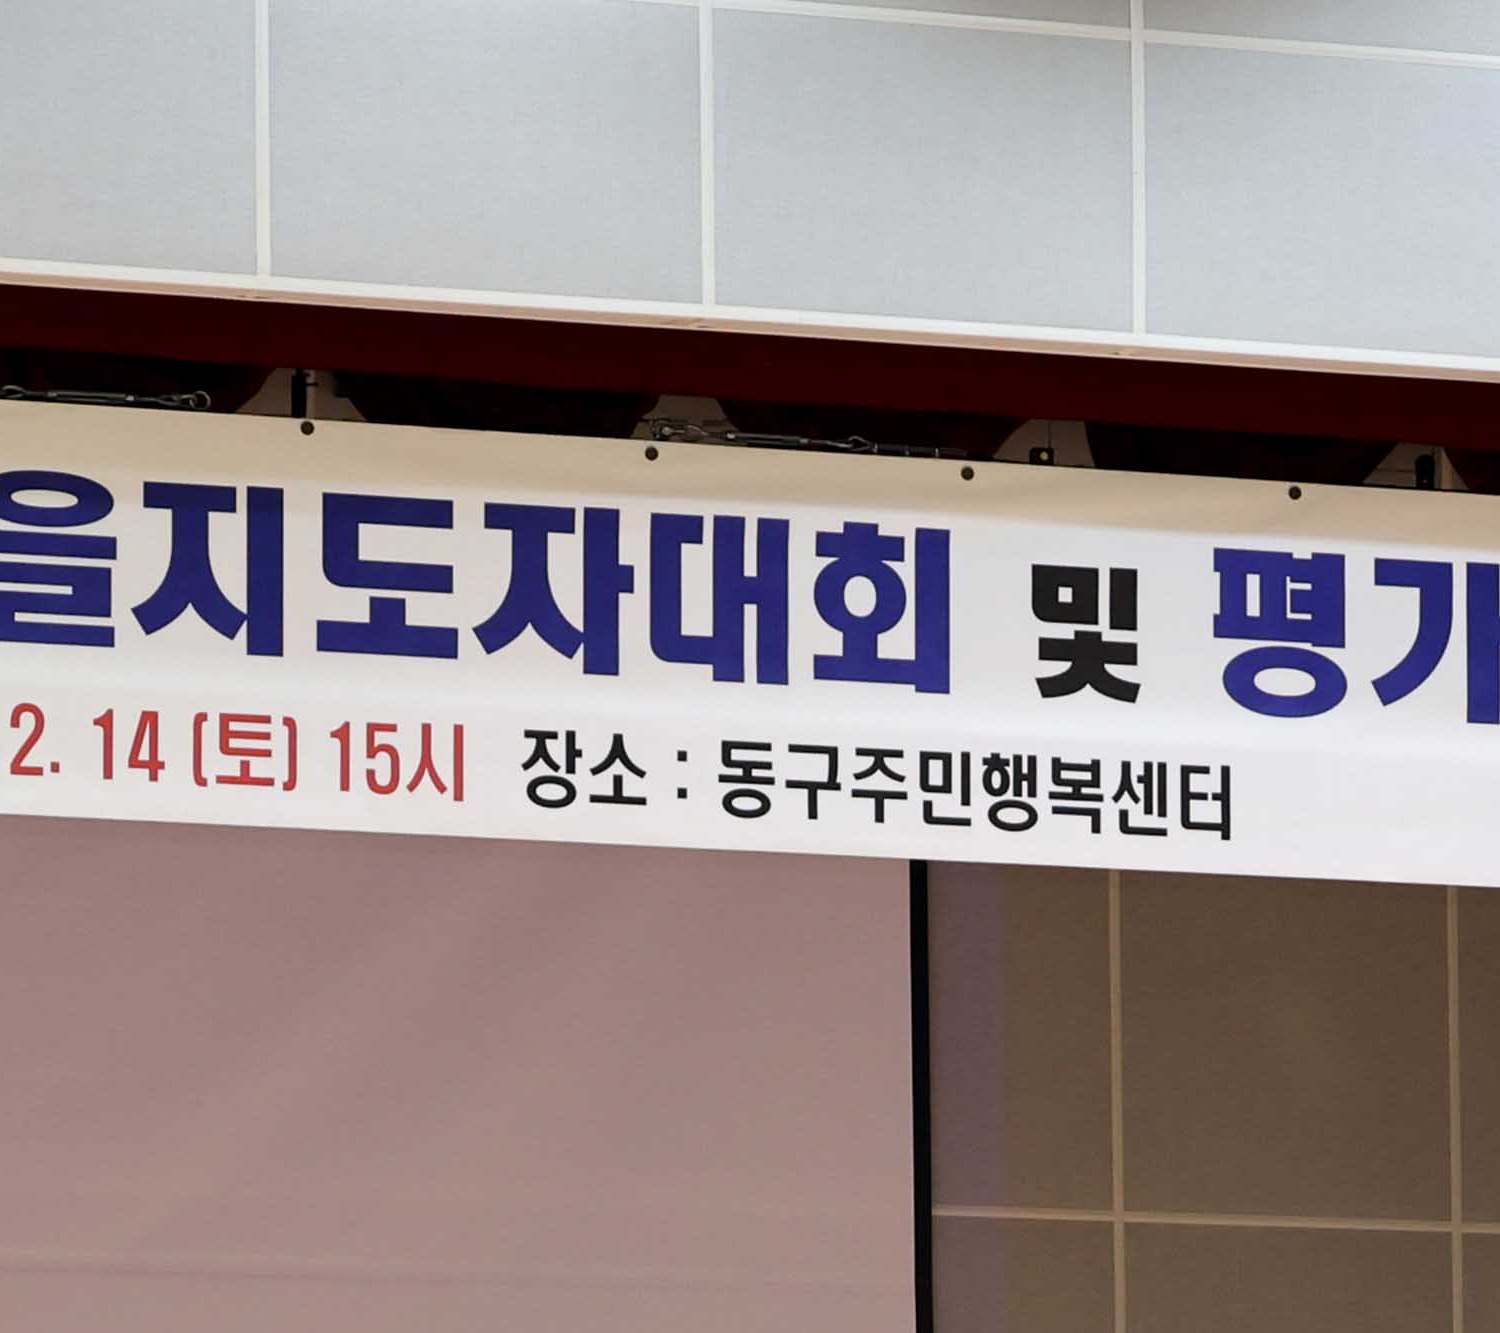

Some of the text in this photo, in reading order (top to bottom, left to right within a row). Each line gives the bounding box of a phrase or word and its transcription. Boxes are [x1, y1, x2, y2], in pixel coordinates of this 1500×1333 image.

[1030, 562, 1142, 705] 및
[93, 709, 166, 783] 14
[329, 721, 465, 802] 15시
[520, 729, 649, 810] 장소
[716, 739, 1233, 843] 동구주민행복센터
